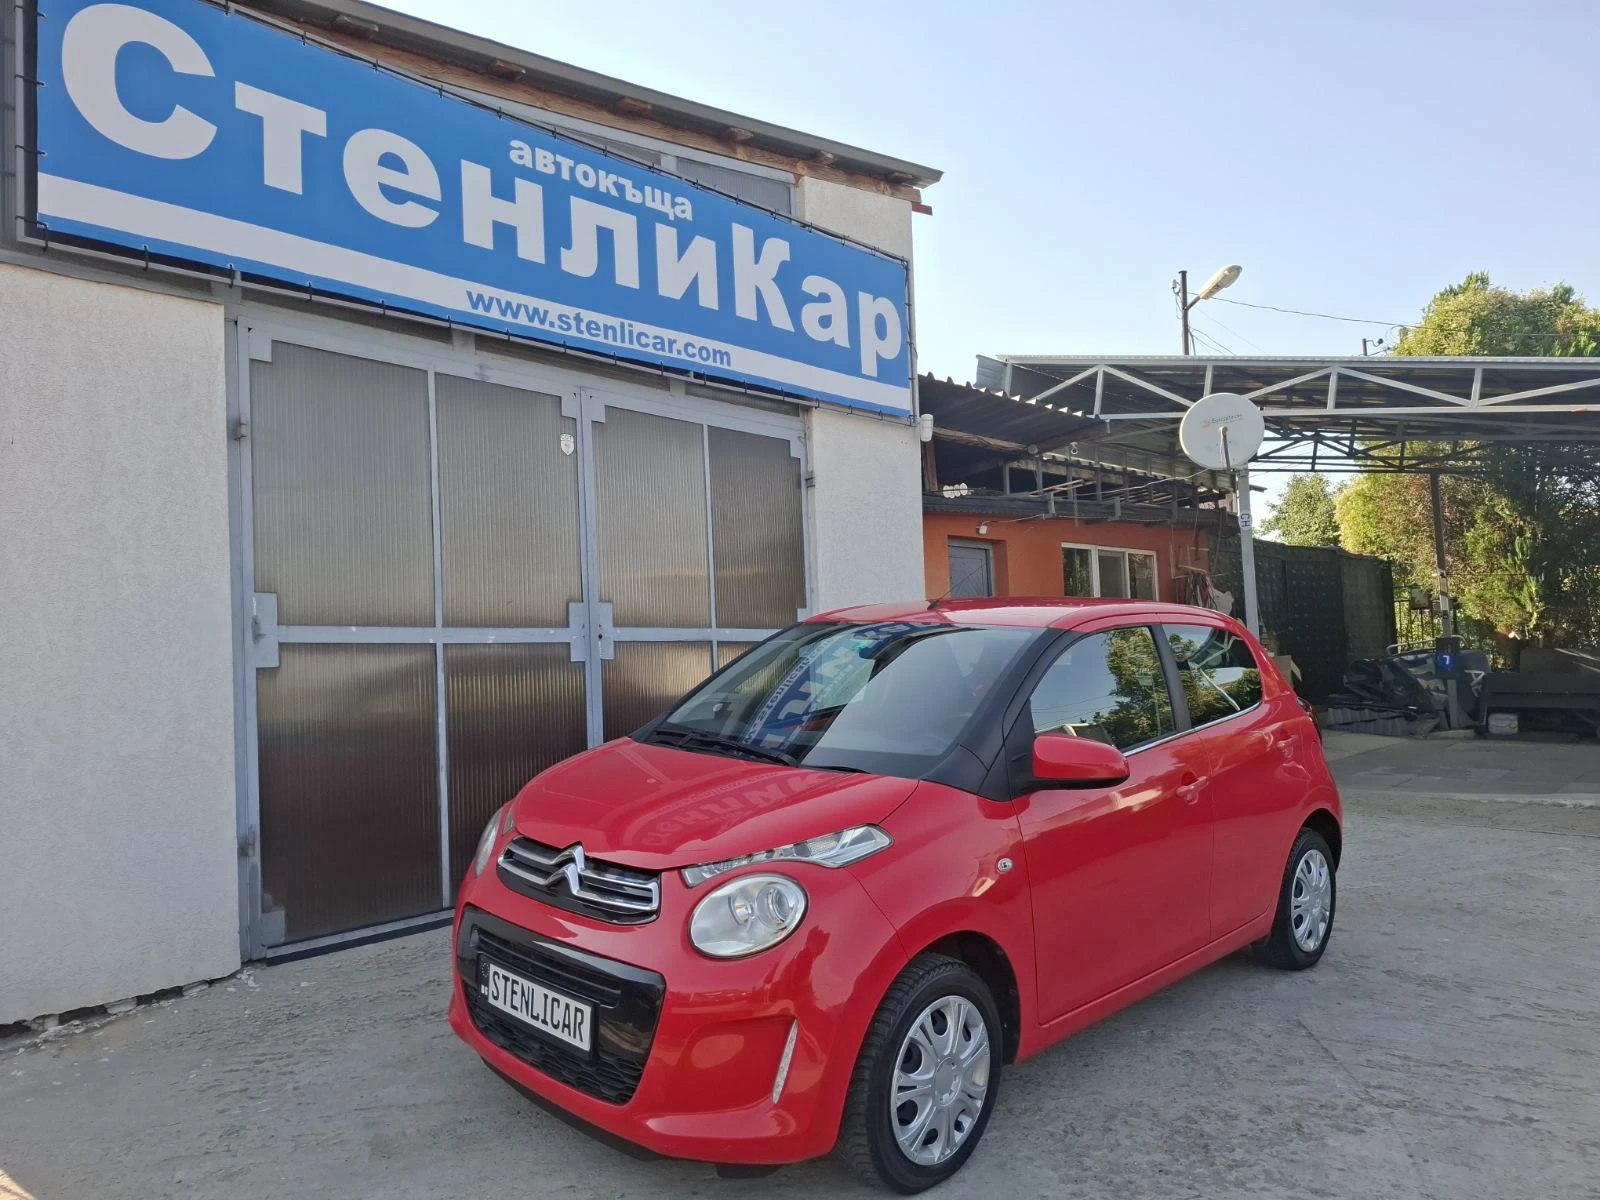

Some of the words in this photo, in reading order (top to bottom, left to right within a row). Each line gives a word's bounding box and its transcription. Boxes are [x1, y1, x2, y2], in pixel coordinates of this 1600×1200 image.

[61, 3, 903, 378] СтенлиКар
[508, 139, 694, 222] автокъща
[465, 289, 733, 369] www.stenlicar.com
[491, 970, 585, 1043] STENLICAR
